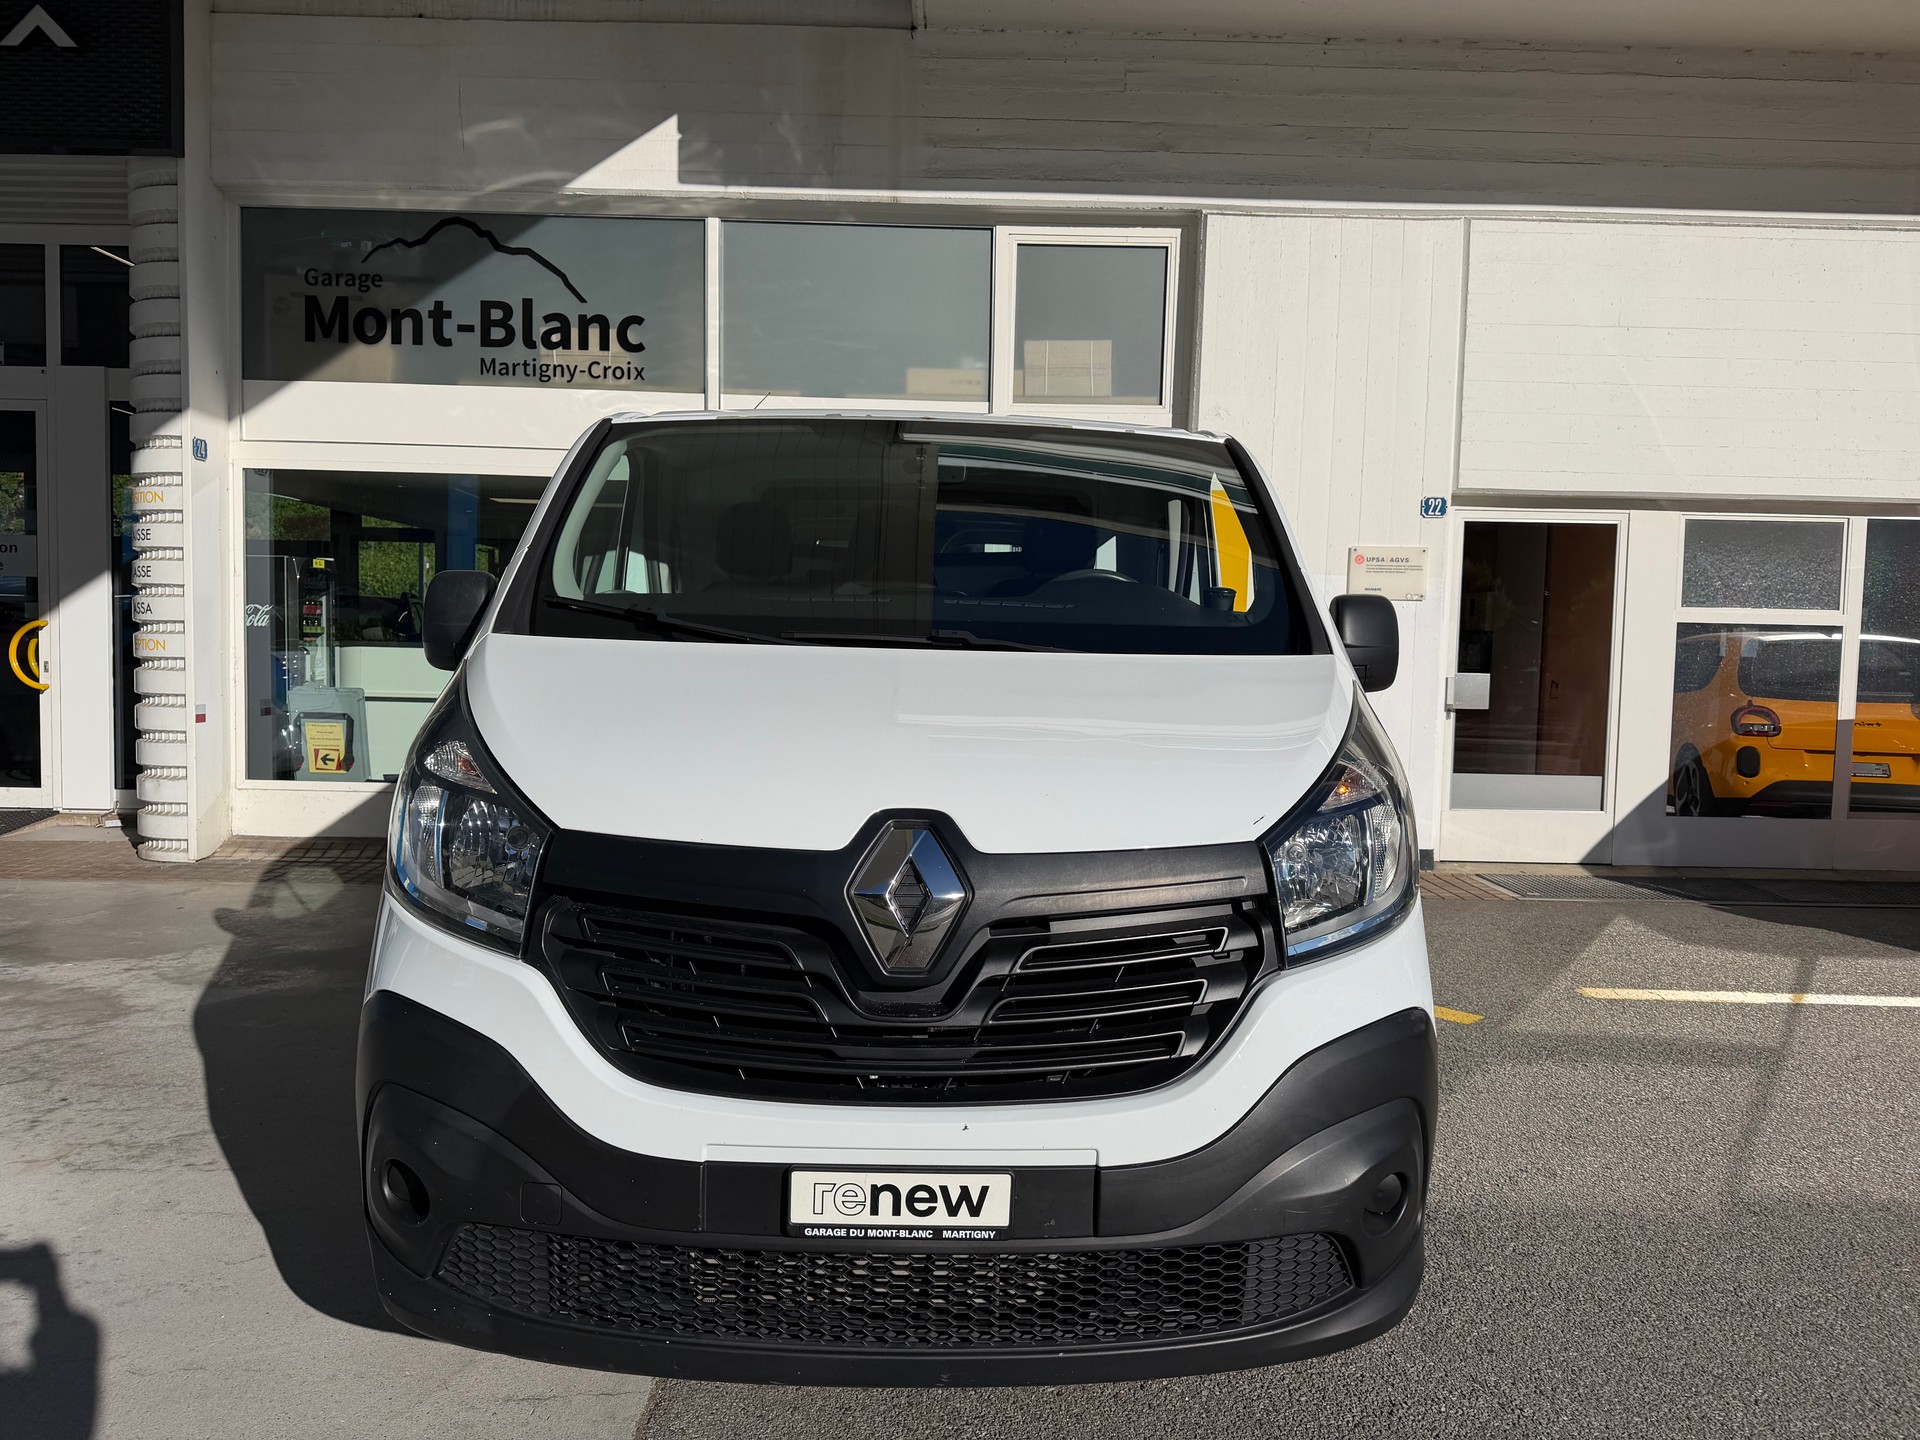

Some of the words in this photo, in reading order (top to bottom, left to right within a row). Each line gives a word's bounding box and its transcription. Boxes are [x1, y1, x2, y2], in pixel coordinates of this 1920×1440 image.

[303, 267, 384, 291] Garage
[304, 294, 646, 353] Mont-Blanc
[479, 357, 646, 383] Martigny-Croix
[197, 440, 206, 458] 24
[1428, 498, 1442, 515] 22
[812, 1182, 990, 1218] renew
[804, 1227, 847, 1238] GARAGE
[849, 1228, 865, 1238] DU
[867, 1228, 934, 1239] MONT-BLANC
[942, 1230, 996, 1240] MARTIGNY
